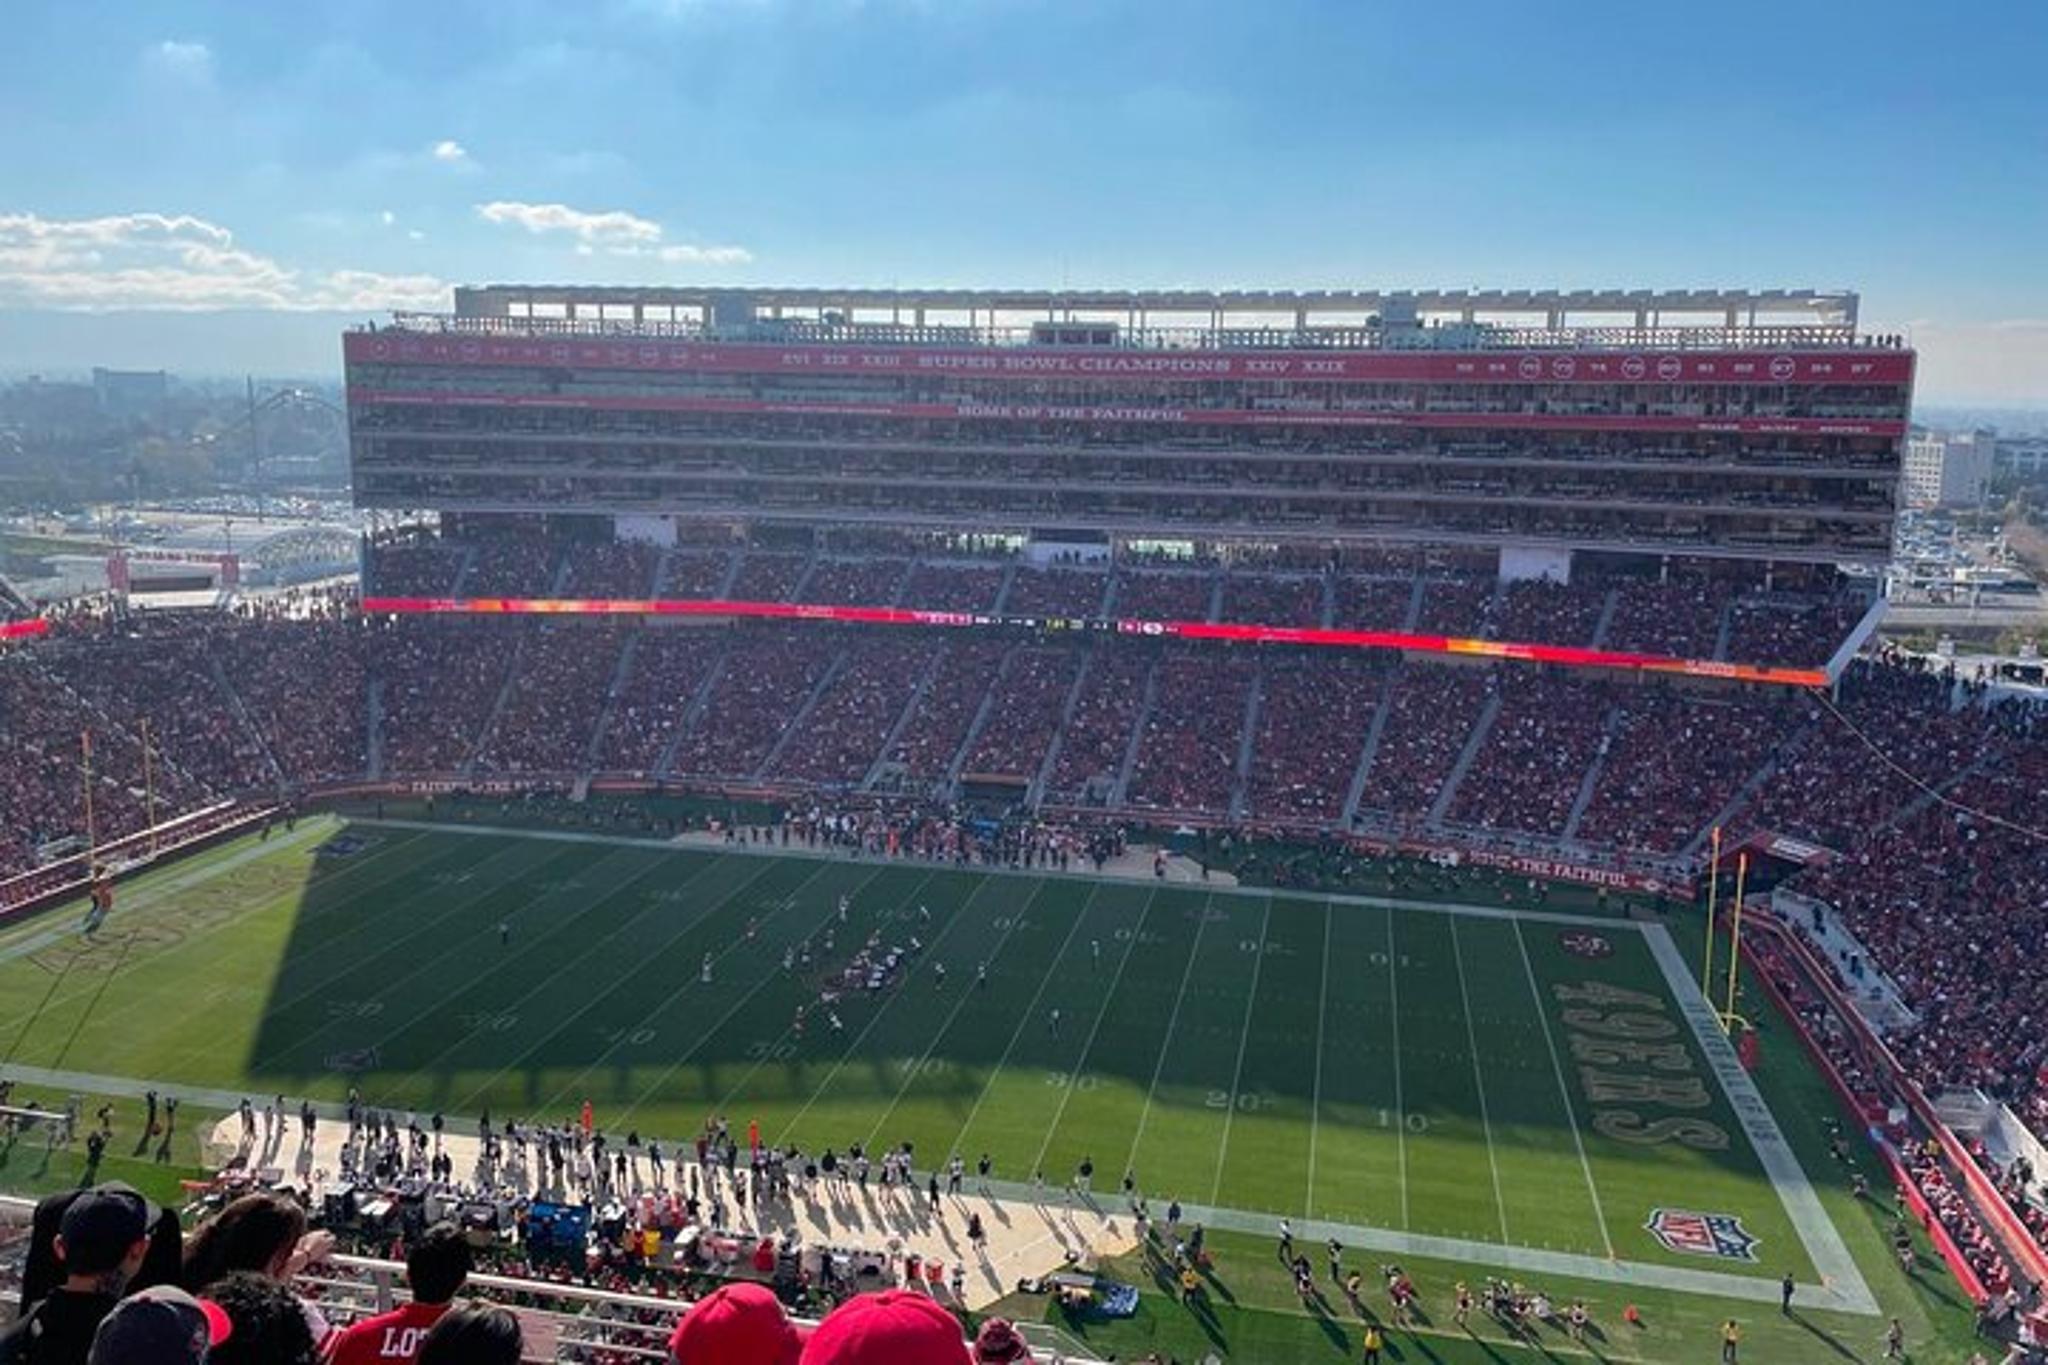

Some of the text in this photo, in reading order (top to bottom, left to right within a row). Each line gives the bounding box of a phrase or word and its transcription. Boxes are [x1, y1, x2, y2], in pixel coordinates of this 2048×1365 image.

[918, 355, 1230, 372] SUPER BOWL CHAMPIONS
[1246, 360, 1345, 373] XXIV XXIX
[957, 405, 1186, 422] HOME OF THE FAITHFUL
[1522, 857, 1550, 874] THE
[1553, 863, 1629, 888] FAITHFUL
[1552, 980, 1730, 1150] 49ERS
[1205, 1089, 1259, 1112] 20
[1379, 1108, 1430, 1133] 10
